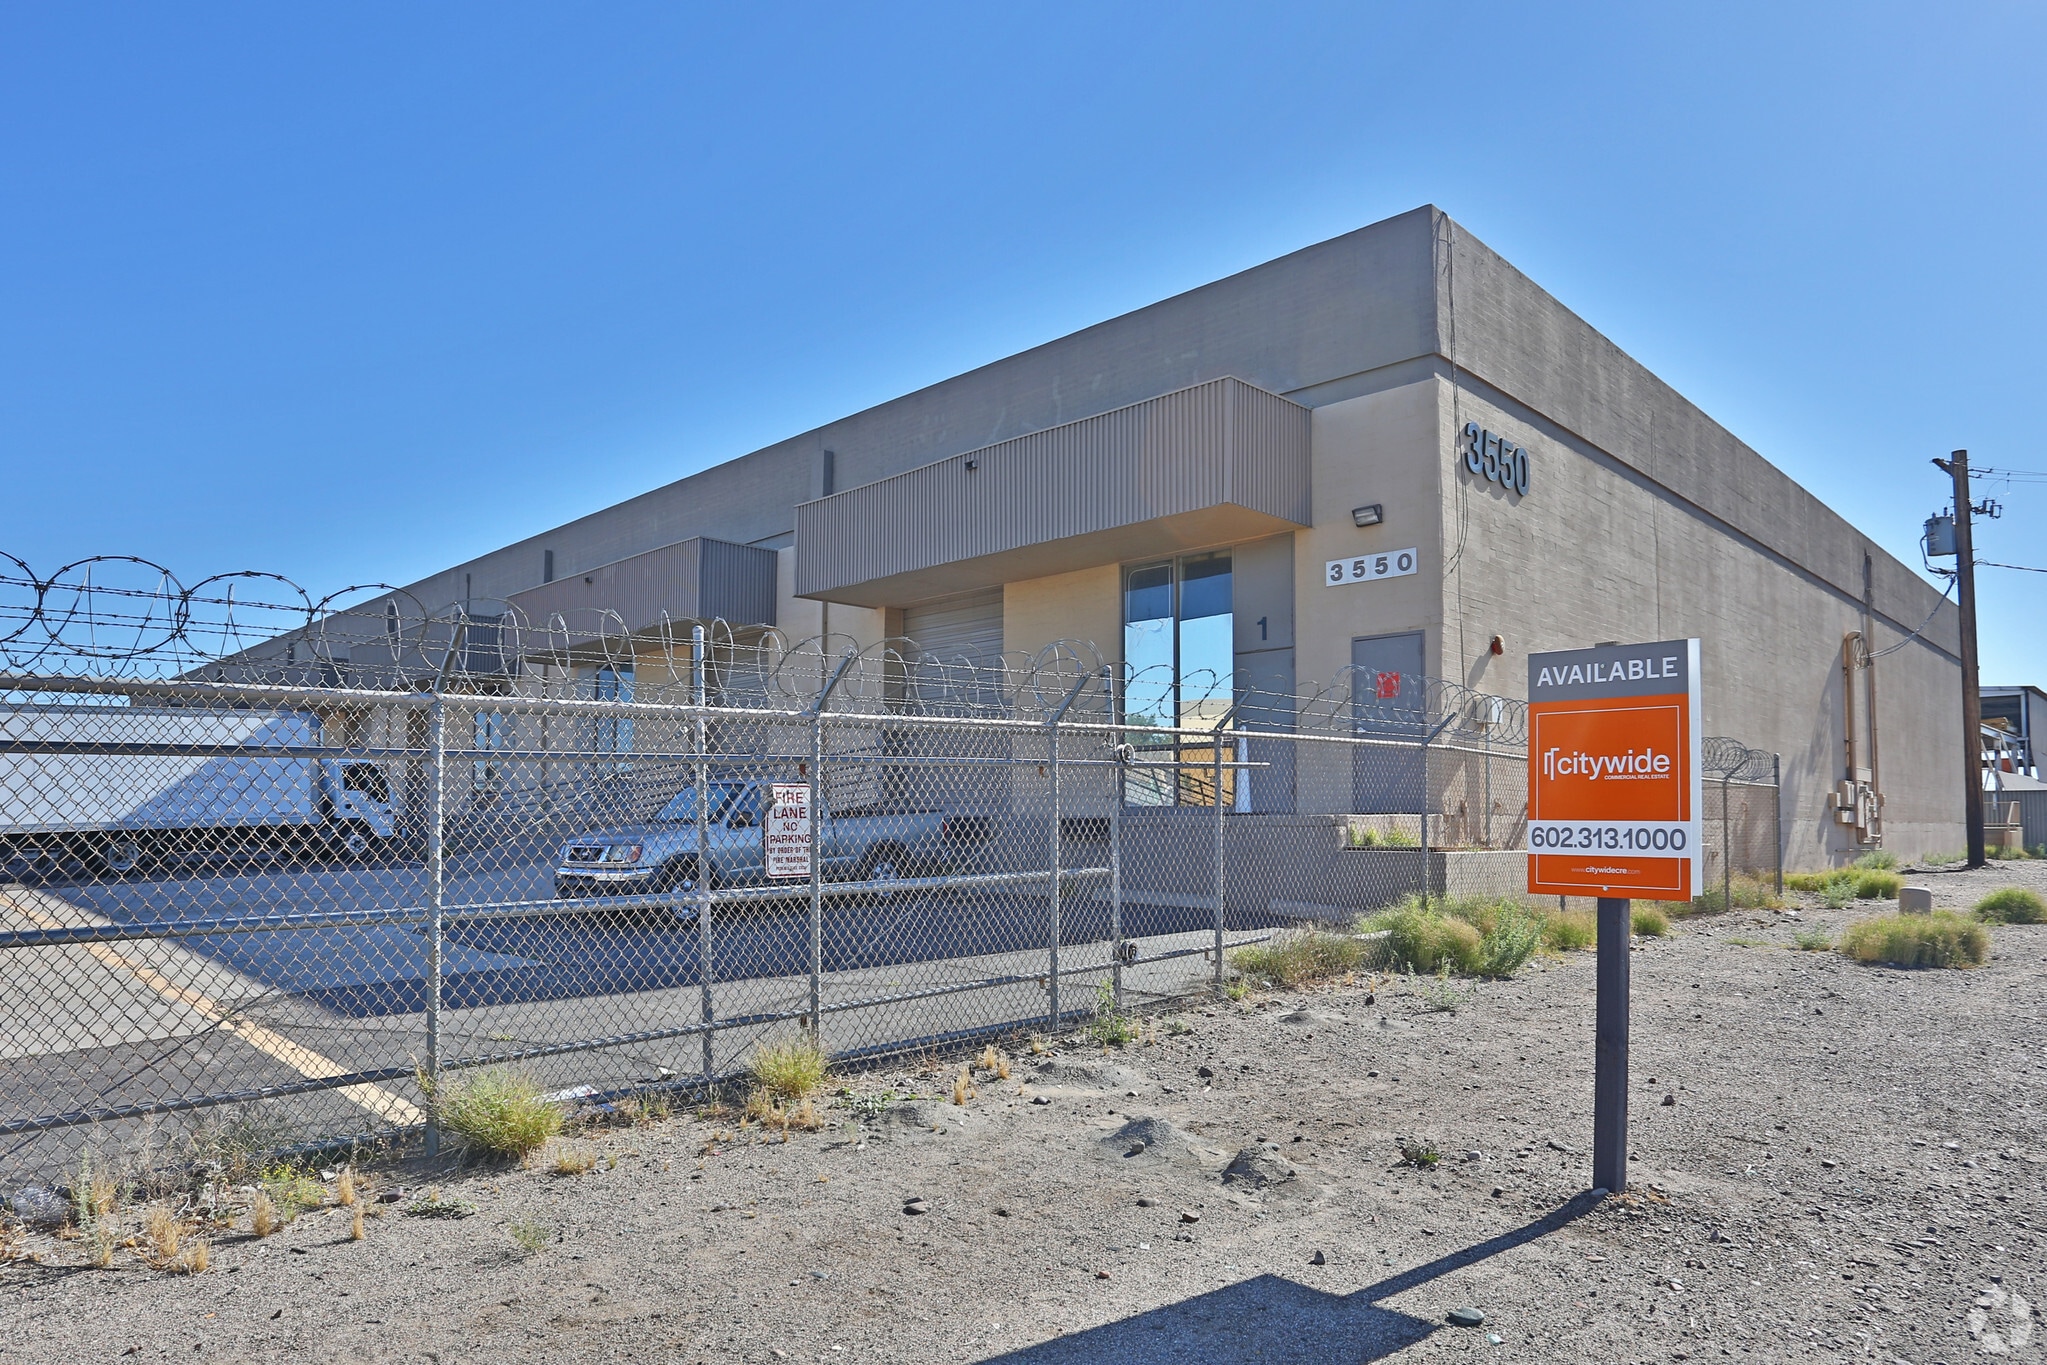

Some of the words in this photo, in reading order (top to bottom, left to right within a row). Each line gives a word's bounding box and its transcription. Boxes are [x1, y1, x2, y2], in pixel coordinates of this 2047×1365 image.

[1464, 421, 1530, 497] 3550
[1329, 552, 1413, 582] 3550
[1256, 616, 1269, 641] 1
[1537, 656, 1678, 687] AVAILABLE
[1557, 747, 1671, 781] citywide
[775, 791, 804, 804] FIRE
[773, 807, 807, 819] LANE
[770, 834, 811, 844] PARKING
[783, 821, 798, 832] NO
[1531, 826, 1687, 851] 602.313.1000
